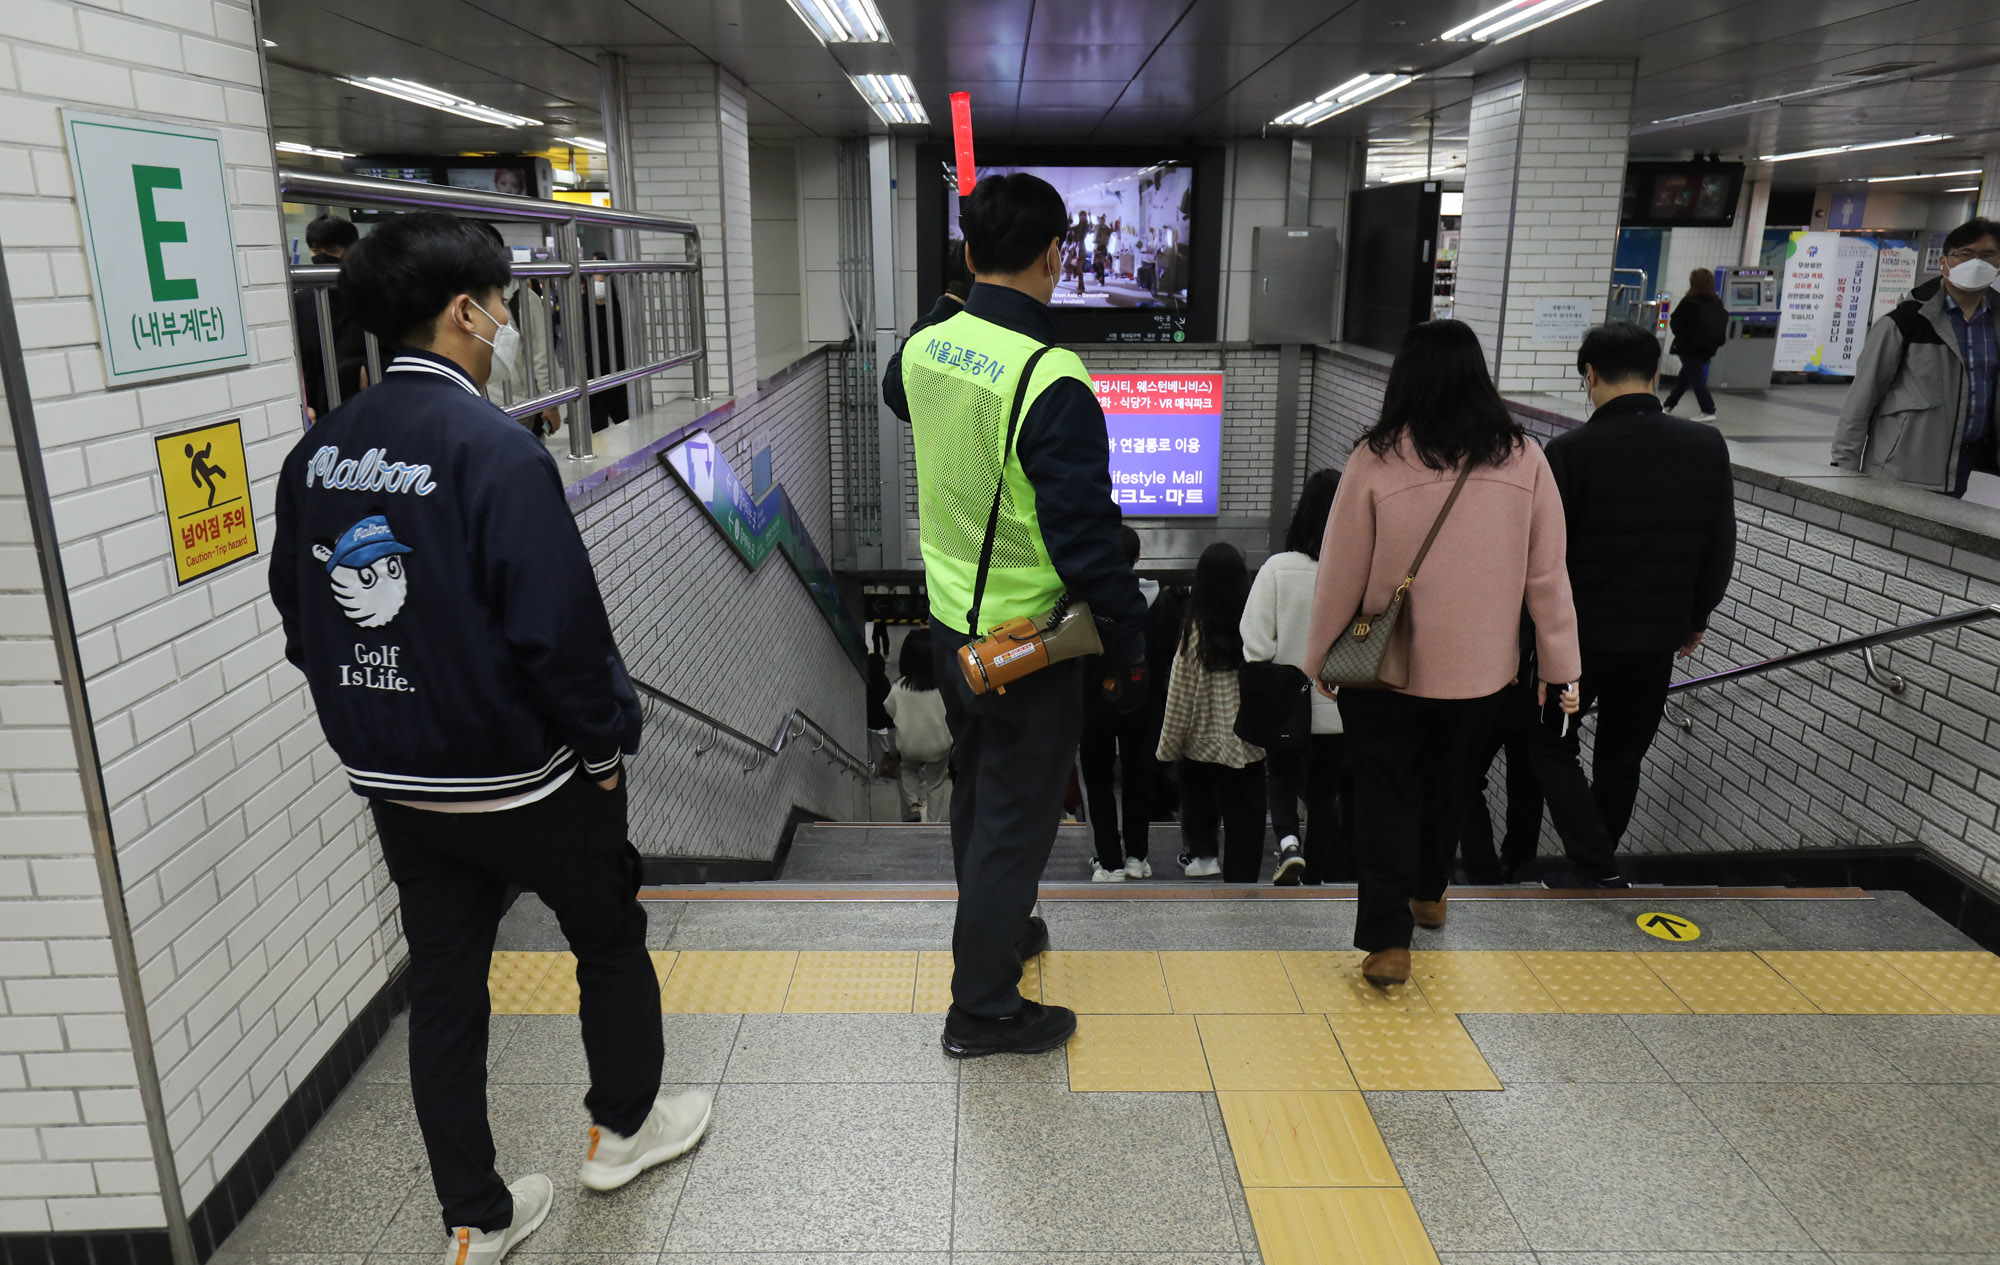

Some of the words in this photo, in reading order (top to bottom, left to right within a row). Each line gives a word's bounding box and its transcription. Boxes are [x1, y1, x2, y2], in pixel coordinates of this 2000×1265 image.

[131, 163, 199, 302] E
[1851, 261, 1864, 293] 코로나19
[131, 306, 225, 351] (내부계단)
[925, 338, 1005, 383] 서울교통공사
[1842, 337, 1853, 360] 위하여
[1136, 380, 1213, 394] 웨스턴베니비스)
[1119, 396, 1151, 409] 식당가
[1159, 399, 1173, 409] VR
[1174, 398, 1213, 409] 매직파크
[1120, 437, 1171, 453] 연결통로
[1175, 437, 1201, 453] 이용
[306, 445, 437, 496] Malbon
[1112, 470, 1166, 487] ifestyle
[1172, 470, 1203, 484] Mall
[181, 515, 221, 549] 넘어짐
[222, 505, 246, 534] 주의
[353, 523, 391, 541] Malbon
[186, 543, 228, 567] Caution-Trip
[228, 534, 248, 551] hazard
[354, 643, 400, 668] Golf
